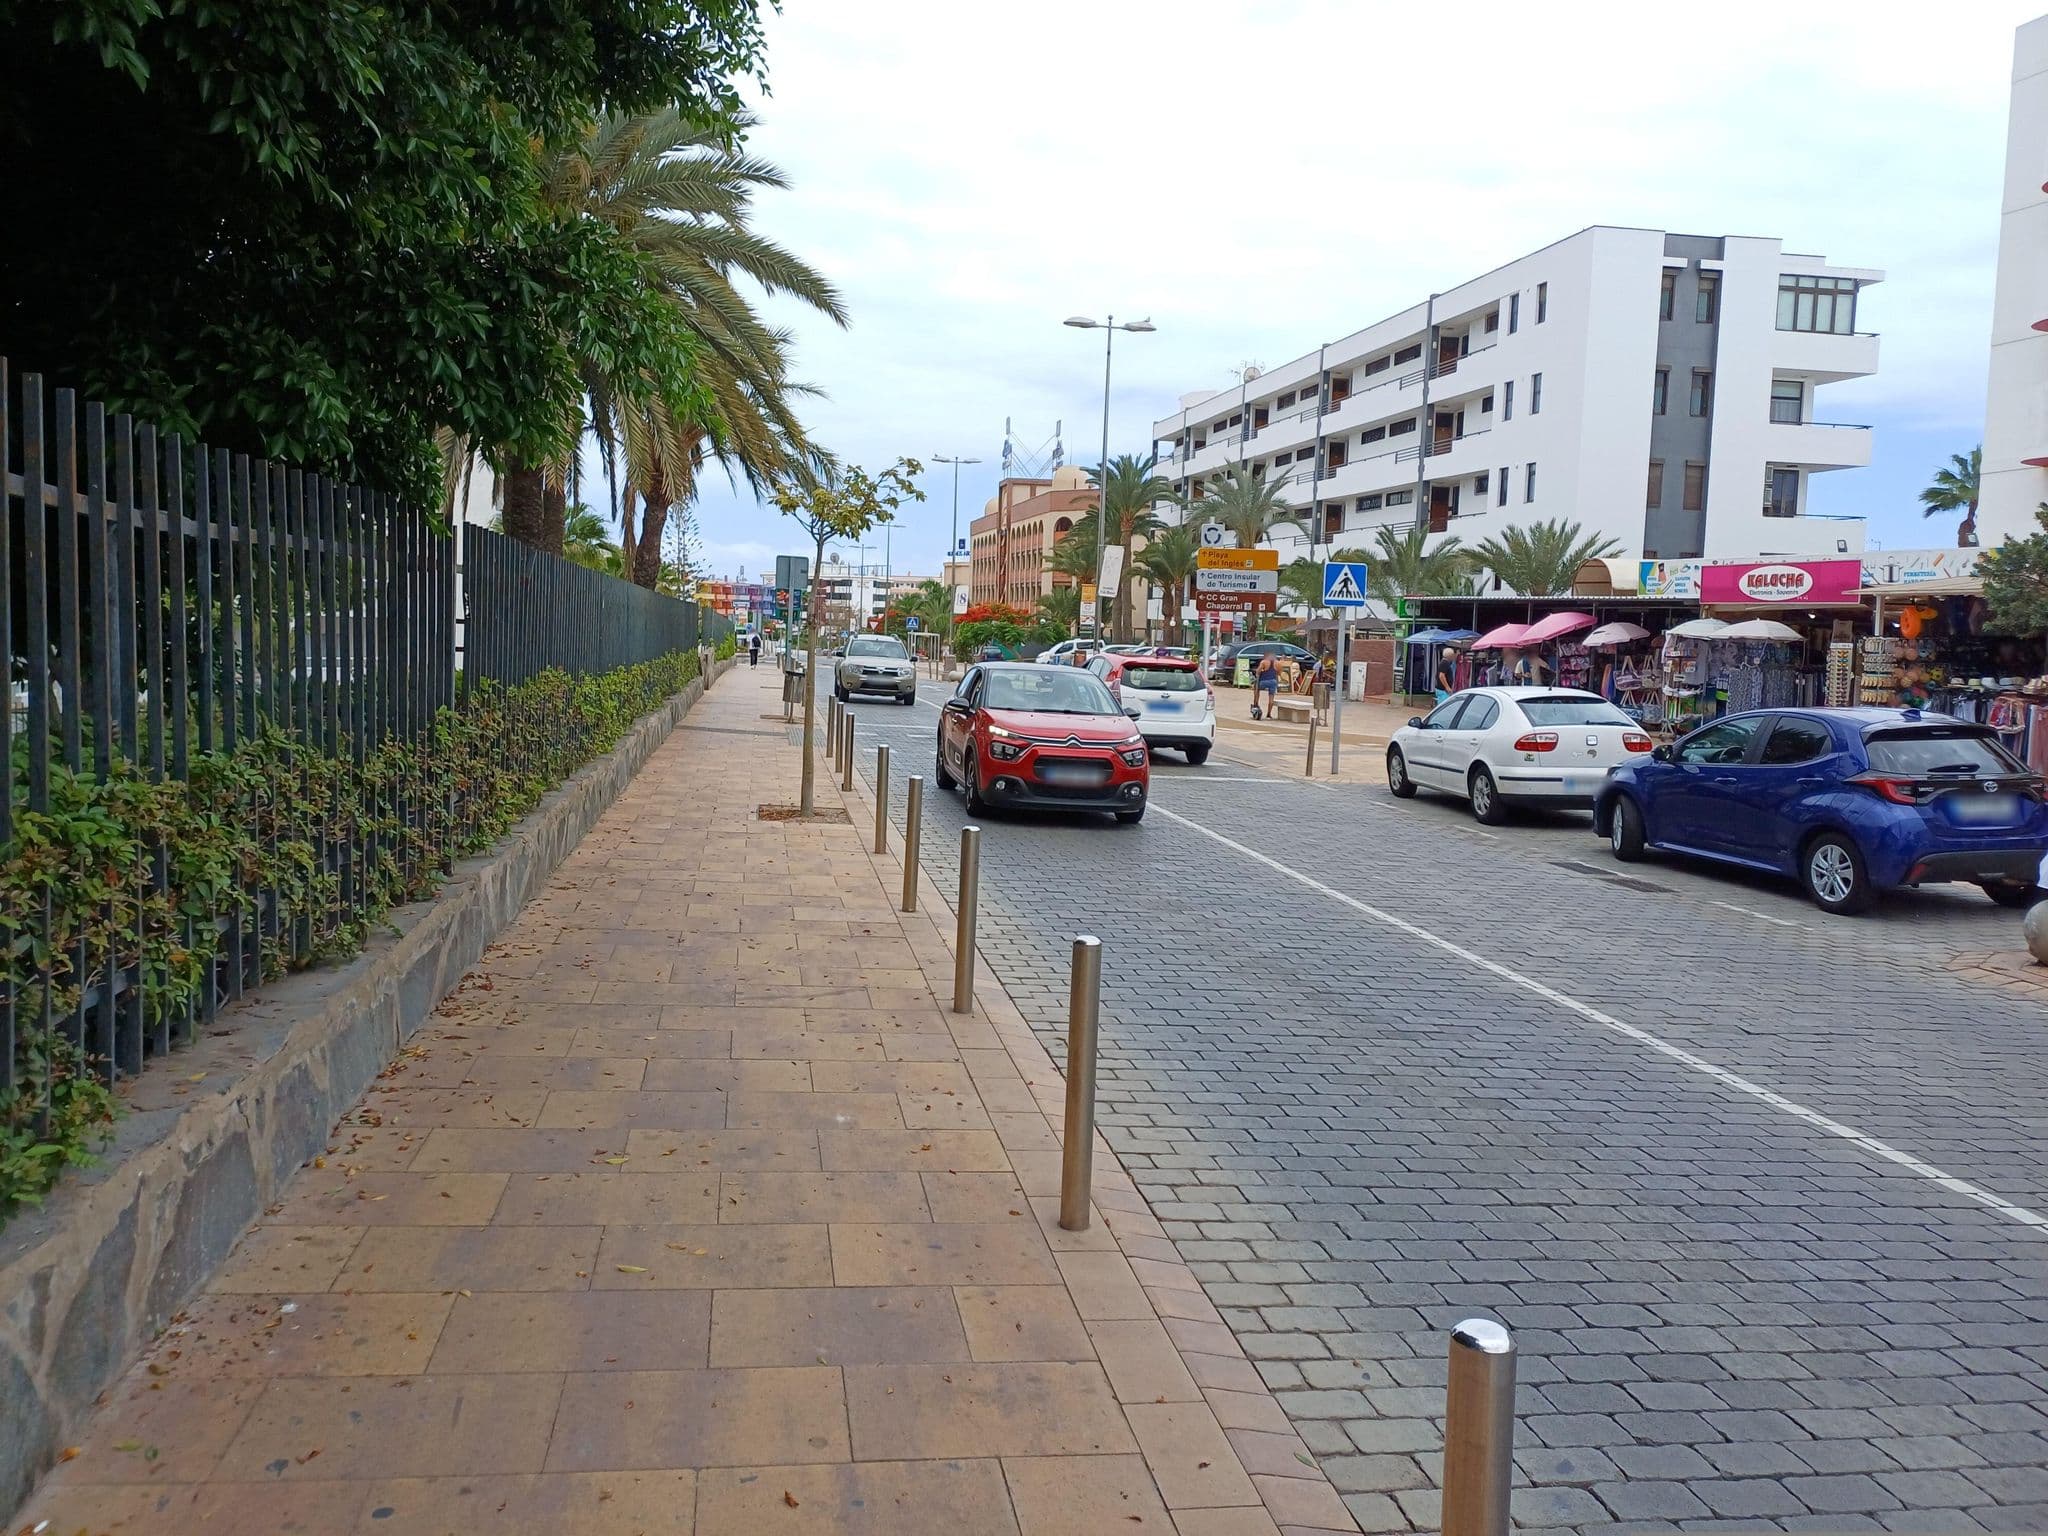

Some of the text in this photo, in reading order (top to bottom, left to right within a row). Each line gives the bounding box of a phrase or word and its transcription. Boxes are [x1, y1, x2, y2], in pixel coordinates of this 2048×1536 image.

[1208, 551, 1229, 559] Playa
[1207, 572, 1233, 580] Centro
[1206, 602, 1243, 610] Chaparral
